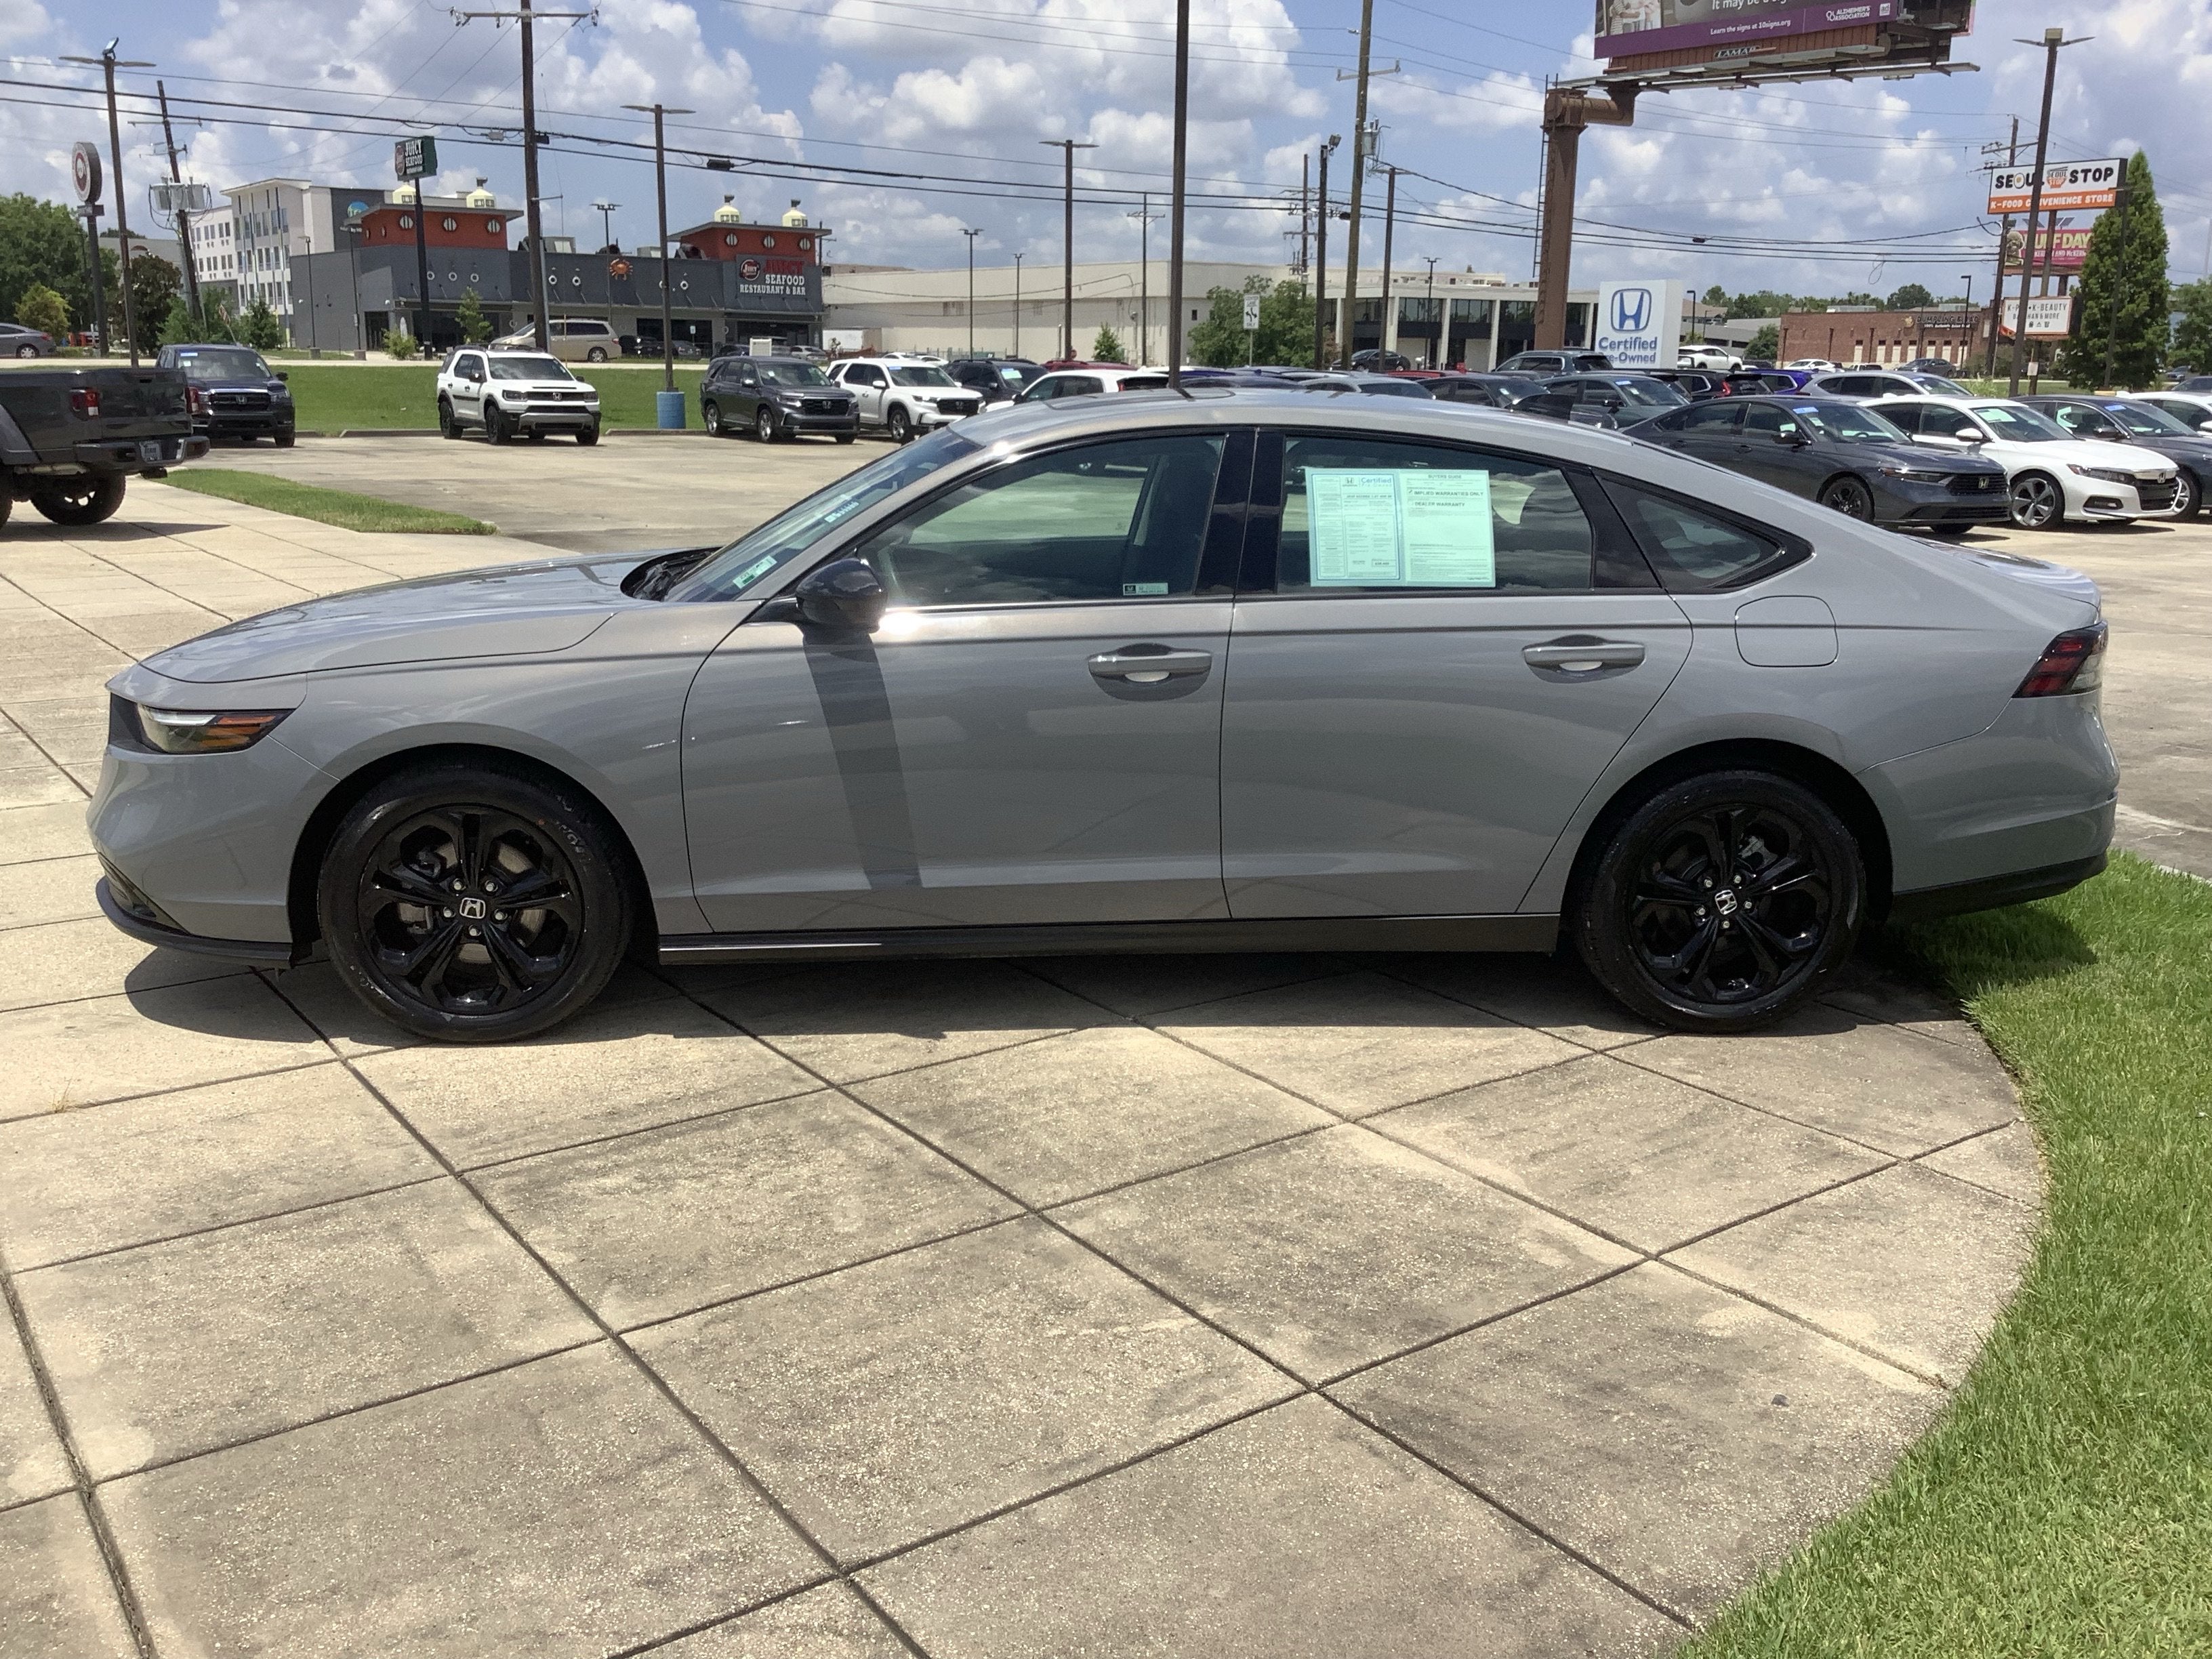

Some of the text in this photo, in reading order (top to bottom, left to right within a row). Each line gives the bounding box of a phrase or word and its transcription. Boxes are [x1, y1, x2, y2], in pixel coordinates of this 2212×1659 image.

[1712, 0, 1720, 10] It
[1722, 0, 1744, 9] may
[1835, 12, 1870, 21] ASSOCIATION
[1737, 24, 1751, 33] signs
[1759, 20, 1791, 29] 10signs.org
[405, 139, 422, 157] JUICY
[1995, 167, 2114, 189] SEOU STOP
[1990, 194, 2114, 209] K-FOOD CVENIENCE STORE
[2062, 232, 2093, 249] DAY
[765, 274, 804, 285] SEAFOOD
[740, 284, 784, 294] RESTAURANT
[792, 286, 806, 295] BAR
[2032, 303, 2067, 311] K-BEAUTY
[1598, 336, 1658, 352] Certified
[1605, 352, 1656, 363] re-Owned
